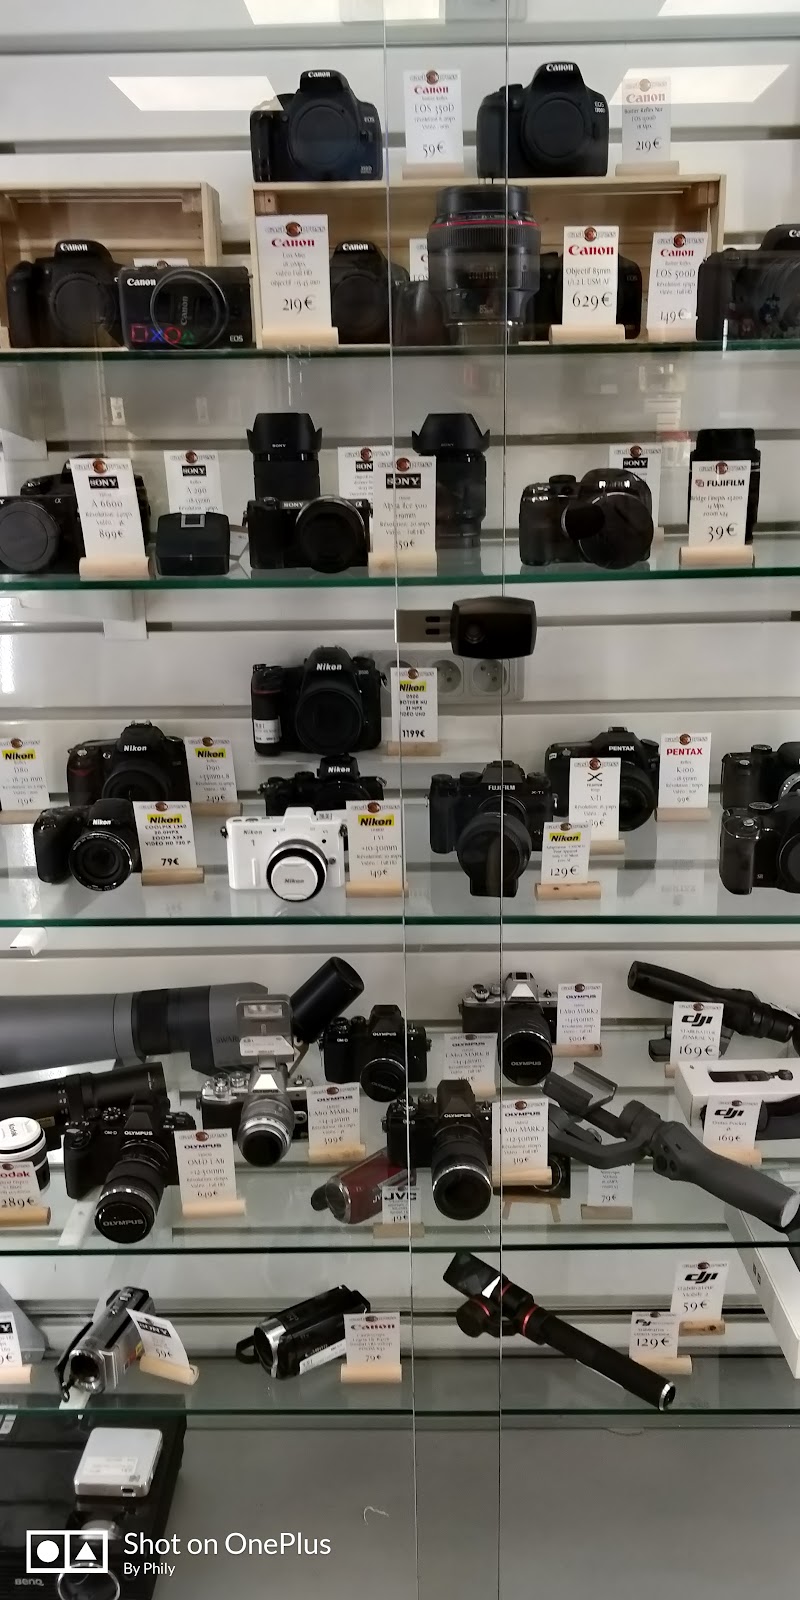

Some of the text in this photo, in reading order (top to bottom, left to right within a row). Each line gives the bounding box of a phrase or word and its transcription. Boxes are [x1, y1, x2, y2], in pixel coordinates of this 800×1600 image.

[546, 63, 574, 72] Canon
[413, 85, 449, 95] Canon
[625, 93, 667, 104] Canon
[414, 104, 432, 113] EOS
[422, 140, 447, 159] 59€
[635, 137, 663, 153] 219€
[60, 243, 89, 252] Canon
[271, 239, 315, 248] Canon
[342, 242, 369, 251] Canon
[568, 244, 615, 257] Canon
[660, 248, 695, 258] Canon
[565, 266, 591, 279] Objectif
[655, 268, 672, 279] EOS
[126, 278, 157, 287] Canon
[281, 294, 317, 315] 219€
[572, 291, 613, 312] 629€
[180, 295, 189, 326] Canon
[660, 307, 692, 325] 149€
[229, 334, 244, 343] EOS
[356, 461, 373, 471] SON
[623, 458, 648, 467] SONY
[182, 467, 207, 476] SONY
[89, 478, 118, 489] SONY
[386, 474, 420, 487] SONY
[707, 479, 746, 488] FUJIFILM
[99, 529, 123, 540] 899€
[708, 522, 739, 543] 39€
[316, 662, 343, 672] Nikon
[399, 683, 425, 692] Nikon
[402, 729, 426, 739] 1199€
[123, 744, 147, 752] Nikon
[666, 747, 703, 756] PENTAX
[5, 752, 34, 760] Nikon
[197, 750, 225, 759] Nikon
[327, 766, 351, 774] Nikon
[488, 784, 516, 792] FUJIFILM
[92, 818, 112, 826] Nikon
[149, 816, 180, 824] Nikon
[360, 817, 393, 826] Nikon
[551, 834, 580, 842] Nikon
[160, 857, 180, 867] 79€
[550, 865, 580, 879] 129€
[680, 1042, 717, 1058] 169€
[0, 1170, 30, 1178] odak
[384, 1192, 417, 1200] JVC
[1, 1196, 36, 1208] 289€
[102, 1218, 144, 1227] OLYMPUS
[683, 1301, 709, 1313] 59€
[636, 1337, 671, 1350] 129€
